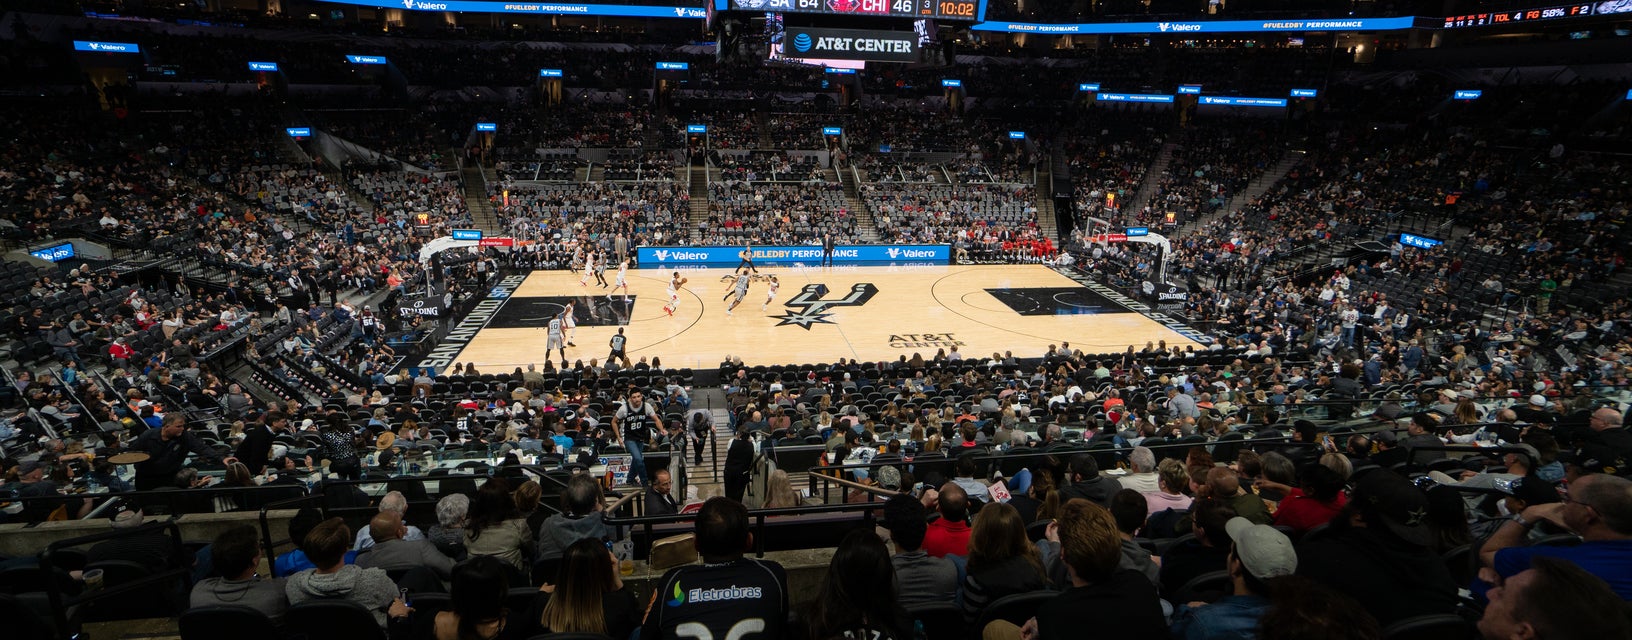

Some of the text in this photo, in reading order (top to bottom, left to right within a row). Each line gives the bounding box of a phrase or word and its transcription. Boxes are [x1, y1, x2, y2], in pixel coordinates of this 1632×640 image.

[417, 2, 447, 10] Valero
[769, 0, 790, 8] SA
[862, 0, 912, 12] CHI 46
[924, 0, 931, 8] 3
[940, 2, 974, 15] 10:02
[688, 9, 706, 17] Vale
[1494, 6, 1589, 22] TOL 4 FG 58% F 2
[815, 37, 911, 53] AT&T CENTER
[41, 250, 68, 260] Vaero
[671, 250, 707, 260] Valero
[739, 249, 858, 258] #UELEDBY PERFOANCE
[903, 249, 935, 258] Valero
[1158, 292, 1187, 300] SPALDING
[889, 333, 957, 343] AT&T
[889, 340, 967, 349] CENTER
[457, 420, 468, 430] 21
[630, 422, 642, 431] 20
[689, 584, 762, 603] Eletrobras
